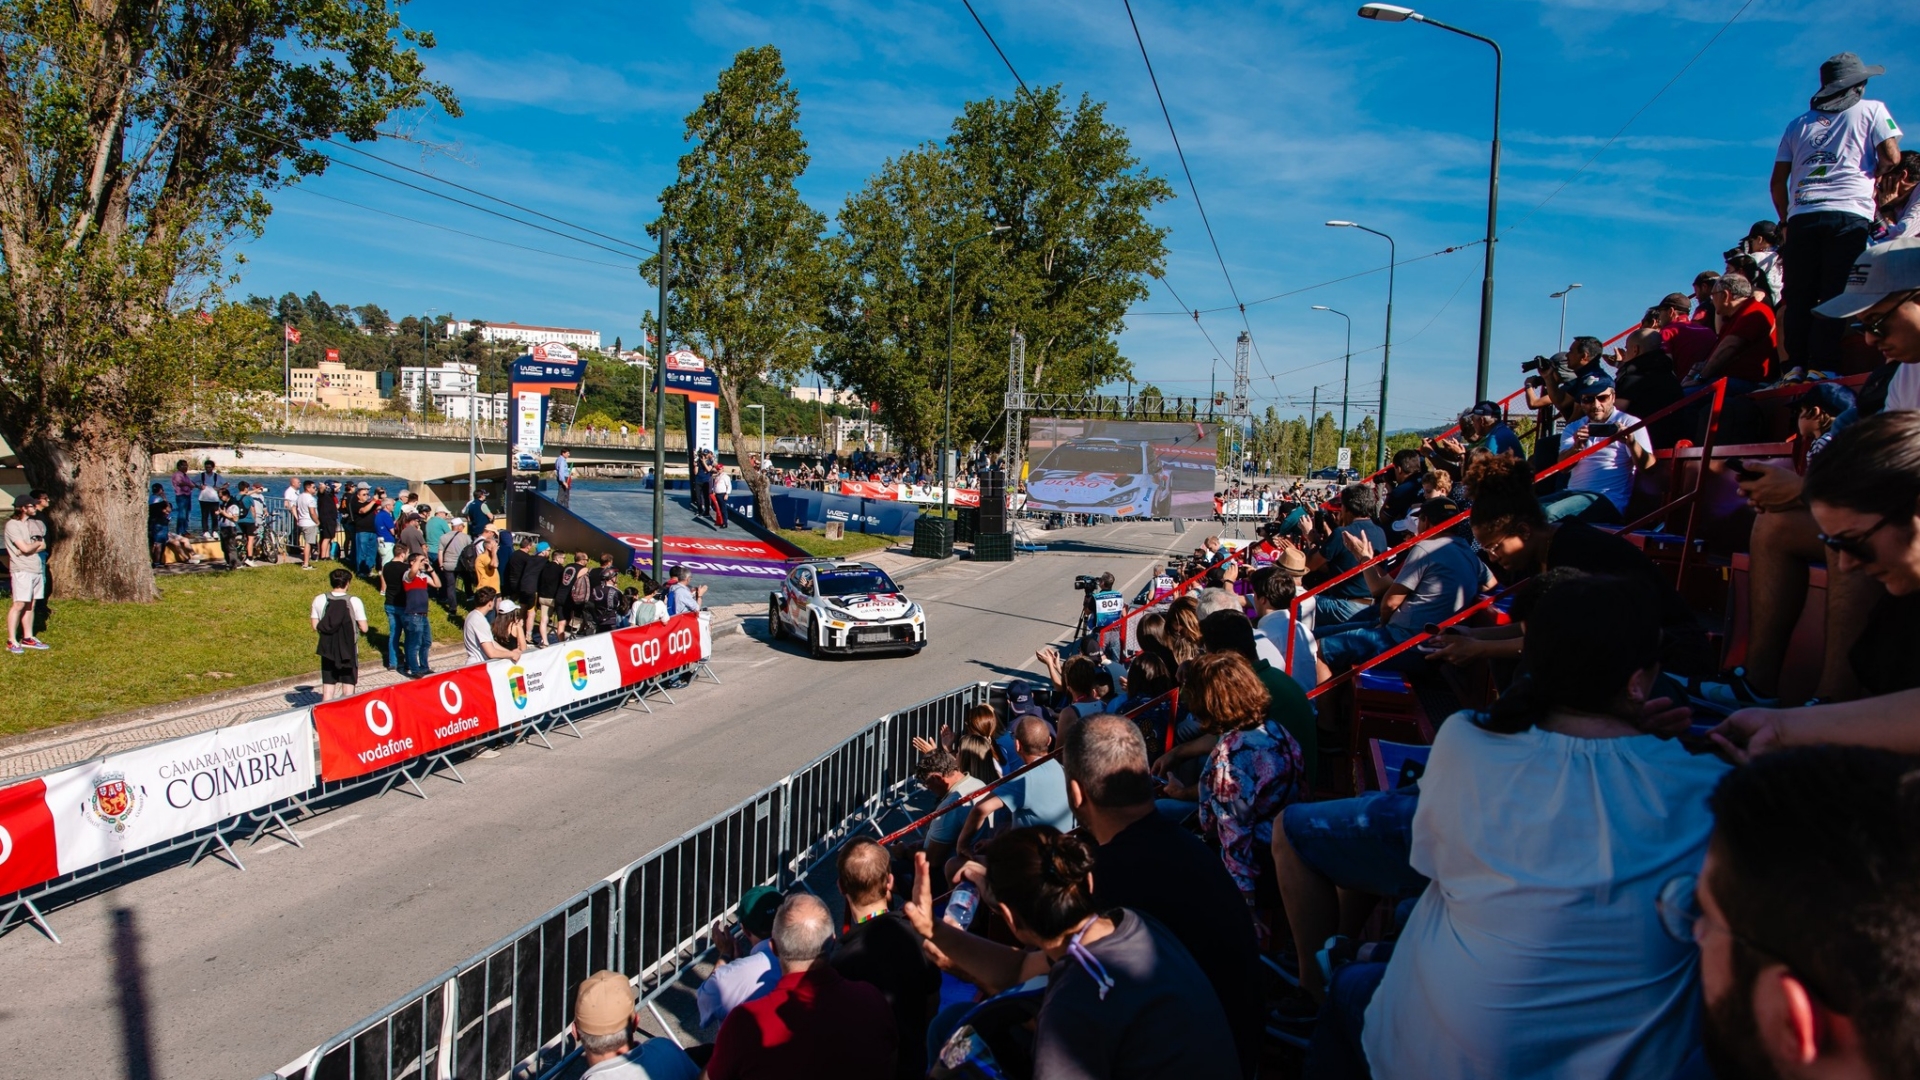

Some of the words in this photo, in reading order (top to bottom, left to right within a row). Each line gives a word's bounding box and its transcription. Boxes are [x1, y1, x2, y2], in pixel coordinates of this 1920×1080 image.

[1044, 479, 1100, 489] DENSO
[827, 509, 849, 517] WRC
[662, 541, 767, 554] vodafone
[857, 601, 895, 609] DENSO
[1101, 600, 1118, 609] 804
[630, 638, 660, 667] acp
[668, 628, 692, 655] acp
[589, 666, 605, 675] Portugal
[526, 671, 542, 680] Turismo
[527, 678, 540, 686] Centro
[528, 683, 544, 692] Portugal
[434, 716, 479, 739] vodafone
[358, 737, 413, 764] vodafone
[158, 752, 221, 779] CÂMARA
[221, 733, 293, 761] MUNICIPAL
[166, 749, 297, 809] COIMBRA
